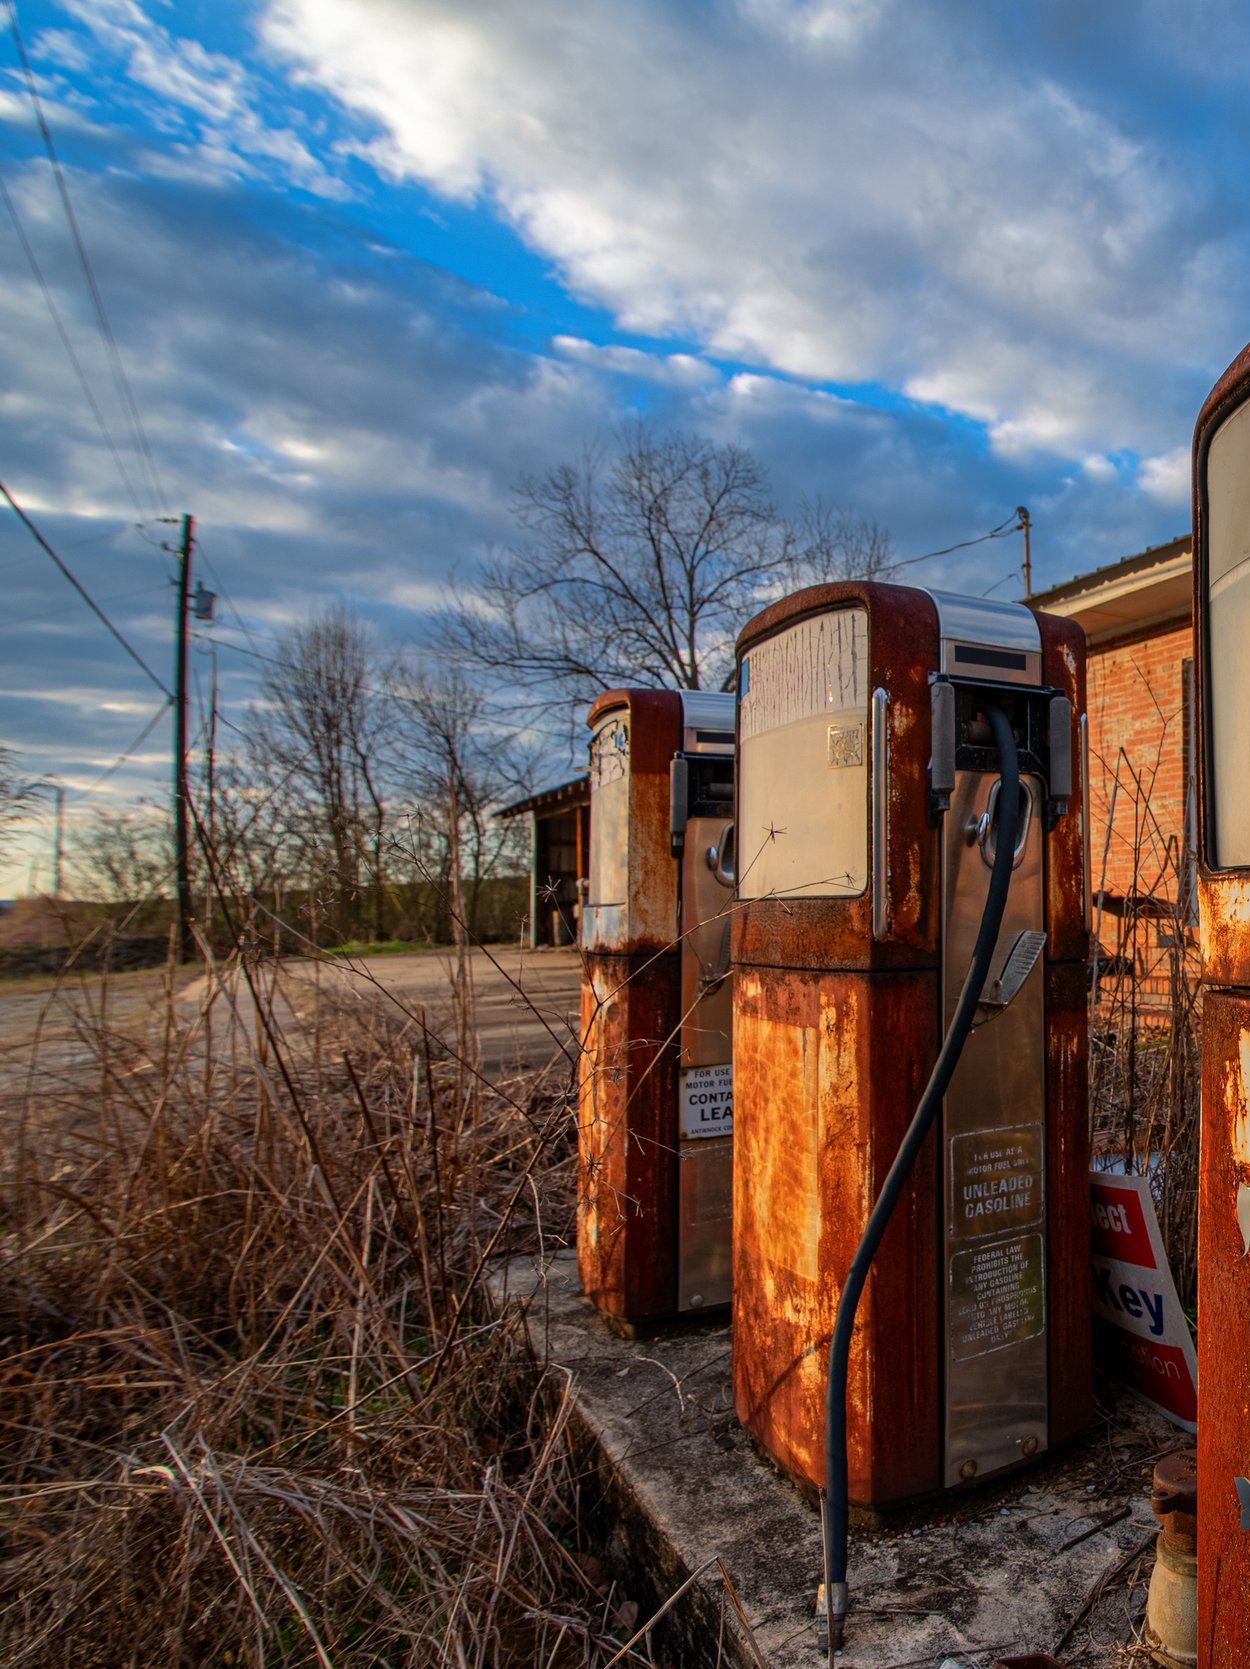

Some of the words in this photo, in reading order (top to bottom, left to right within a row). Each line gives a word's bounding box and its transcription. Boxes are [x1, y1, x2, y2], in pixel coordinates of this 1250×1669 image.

[694, 1070, 711, 1078] FOR
[714, 1068, 730, 1076] USE
[686, 1080, 715, 1089] MOTOR
[689, 1091, 733, 1106] CONTA
[701, 1106, 733, 1121] LEA
[994, 1160, 1011, 1171] FUEL
[963, 1175, 1033, 1201] UNLEADED
[965, 1191, 1031, 1218] GASOLINE
[971, 1256, 1009, 1274] PROHIBITS
[1011, 1252, 1024, 1262] THE
[973, 1248, 1004, 1263] FEDERAL
[1006, 1244, 1021, 1255] LAW
[965, 1263, 1018, 1284] INTRODUCTION
[1020, 1260, 1029, 1269] OF
[974, 1281, 987, 1291] ANY
[989, 1271, 1024, 1288] GASOLINE
[977, 1281, 1020, 1301] CONTAINING
